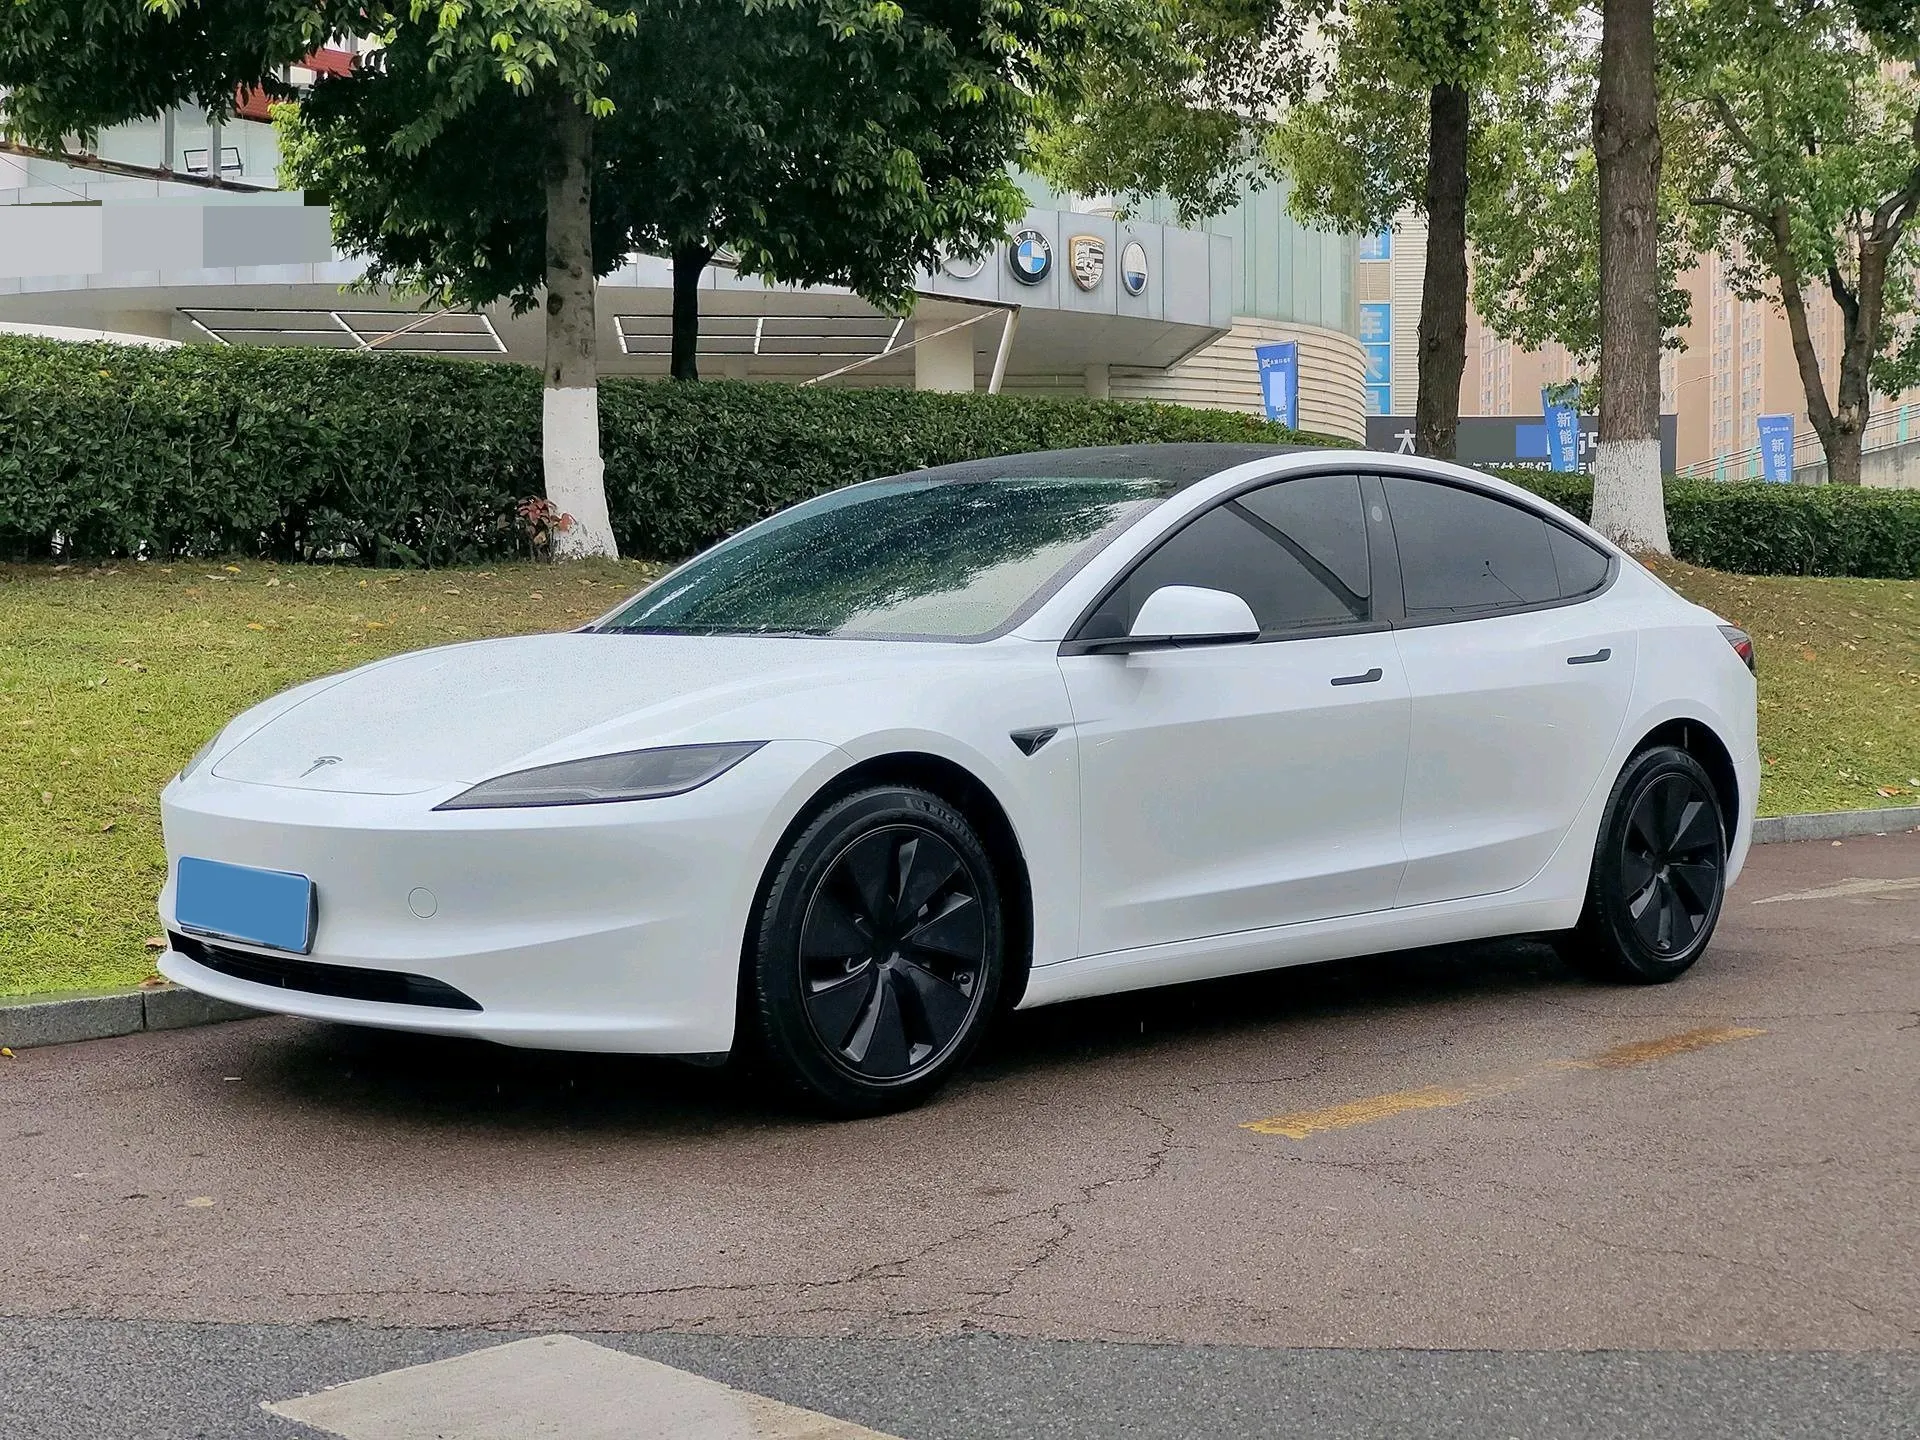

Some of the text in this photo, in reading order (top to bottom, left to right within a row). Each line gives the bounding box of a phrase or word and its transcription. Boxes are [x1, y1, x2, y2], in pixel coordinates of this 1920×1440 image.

[1014, 232, 1050, 251] BMW
[1771, 438, 1787, 482] 新能源
